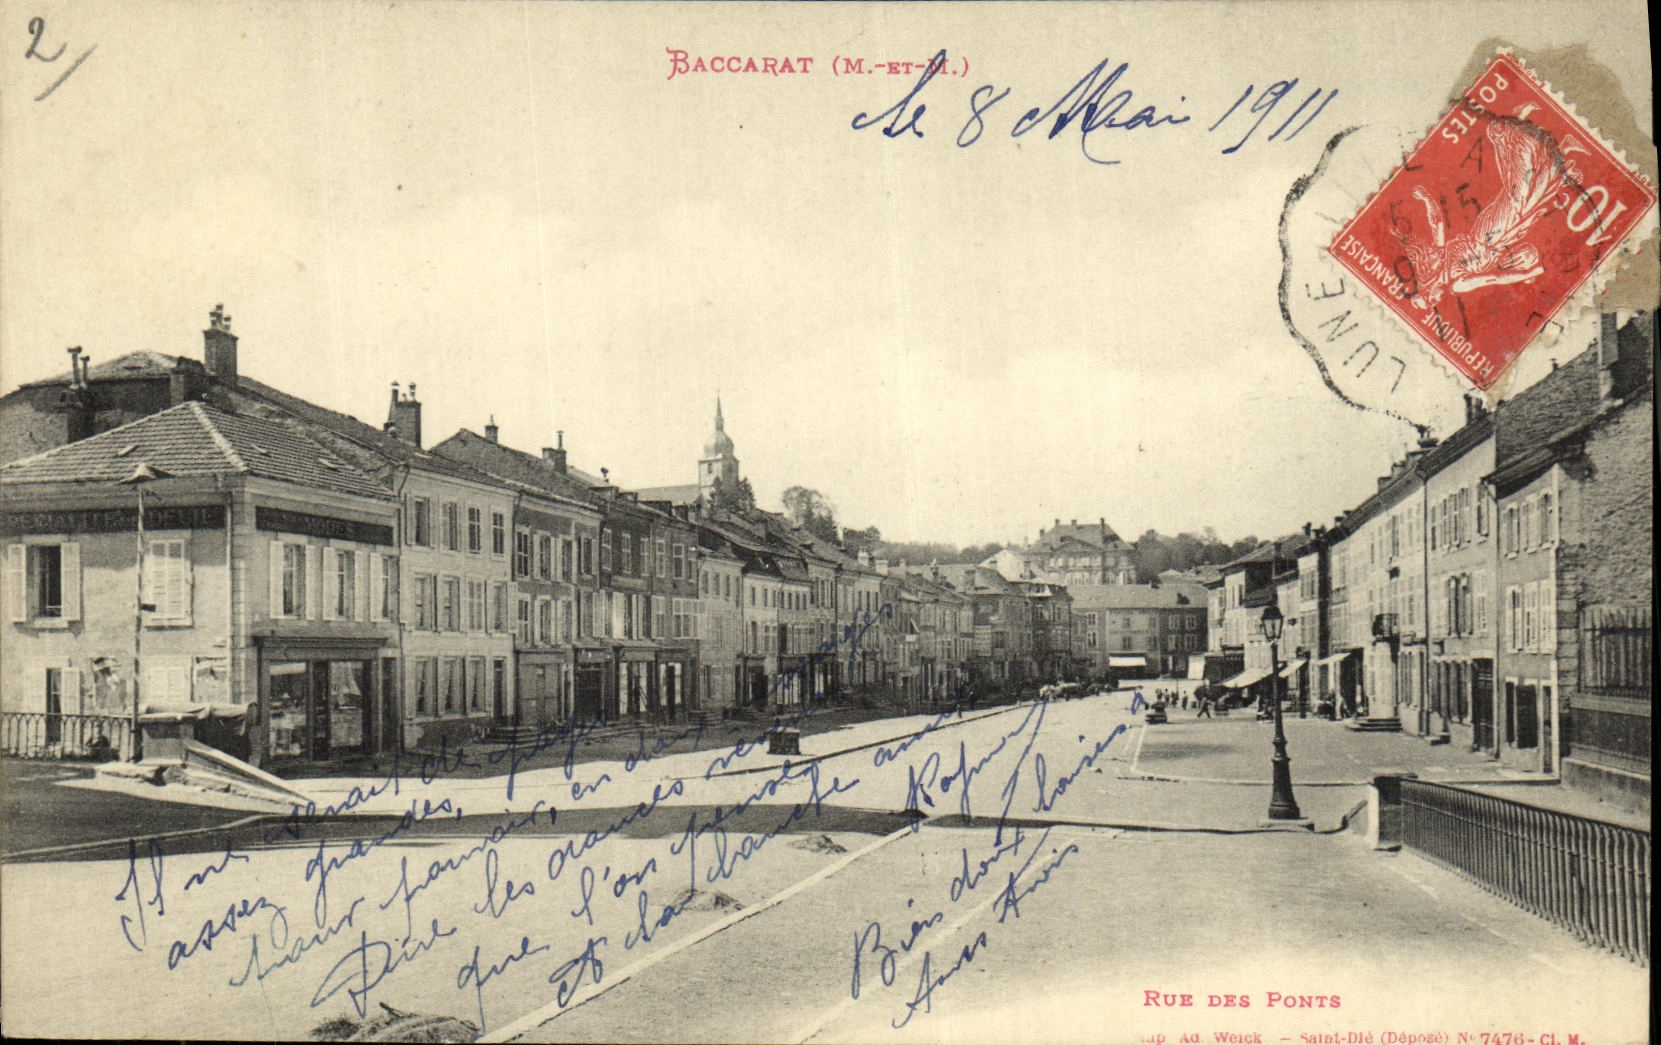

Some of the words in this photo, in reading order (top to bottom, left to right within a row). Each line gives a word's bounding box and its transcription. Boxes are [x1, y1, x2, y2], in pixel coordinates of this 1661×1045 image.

[956, 84, 1011, 147] 8
[1208, 76, 1340, 155] 1911
[1441, 72, 1509, 145] POSTES
[473, 848, 536, 918] les
